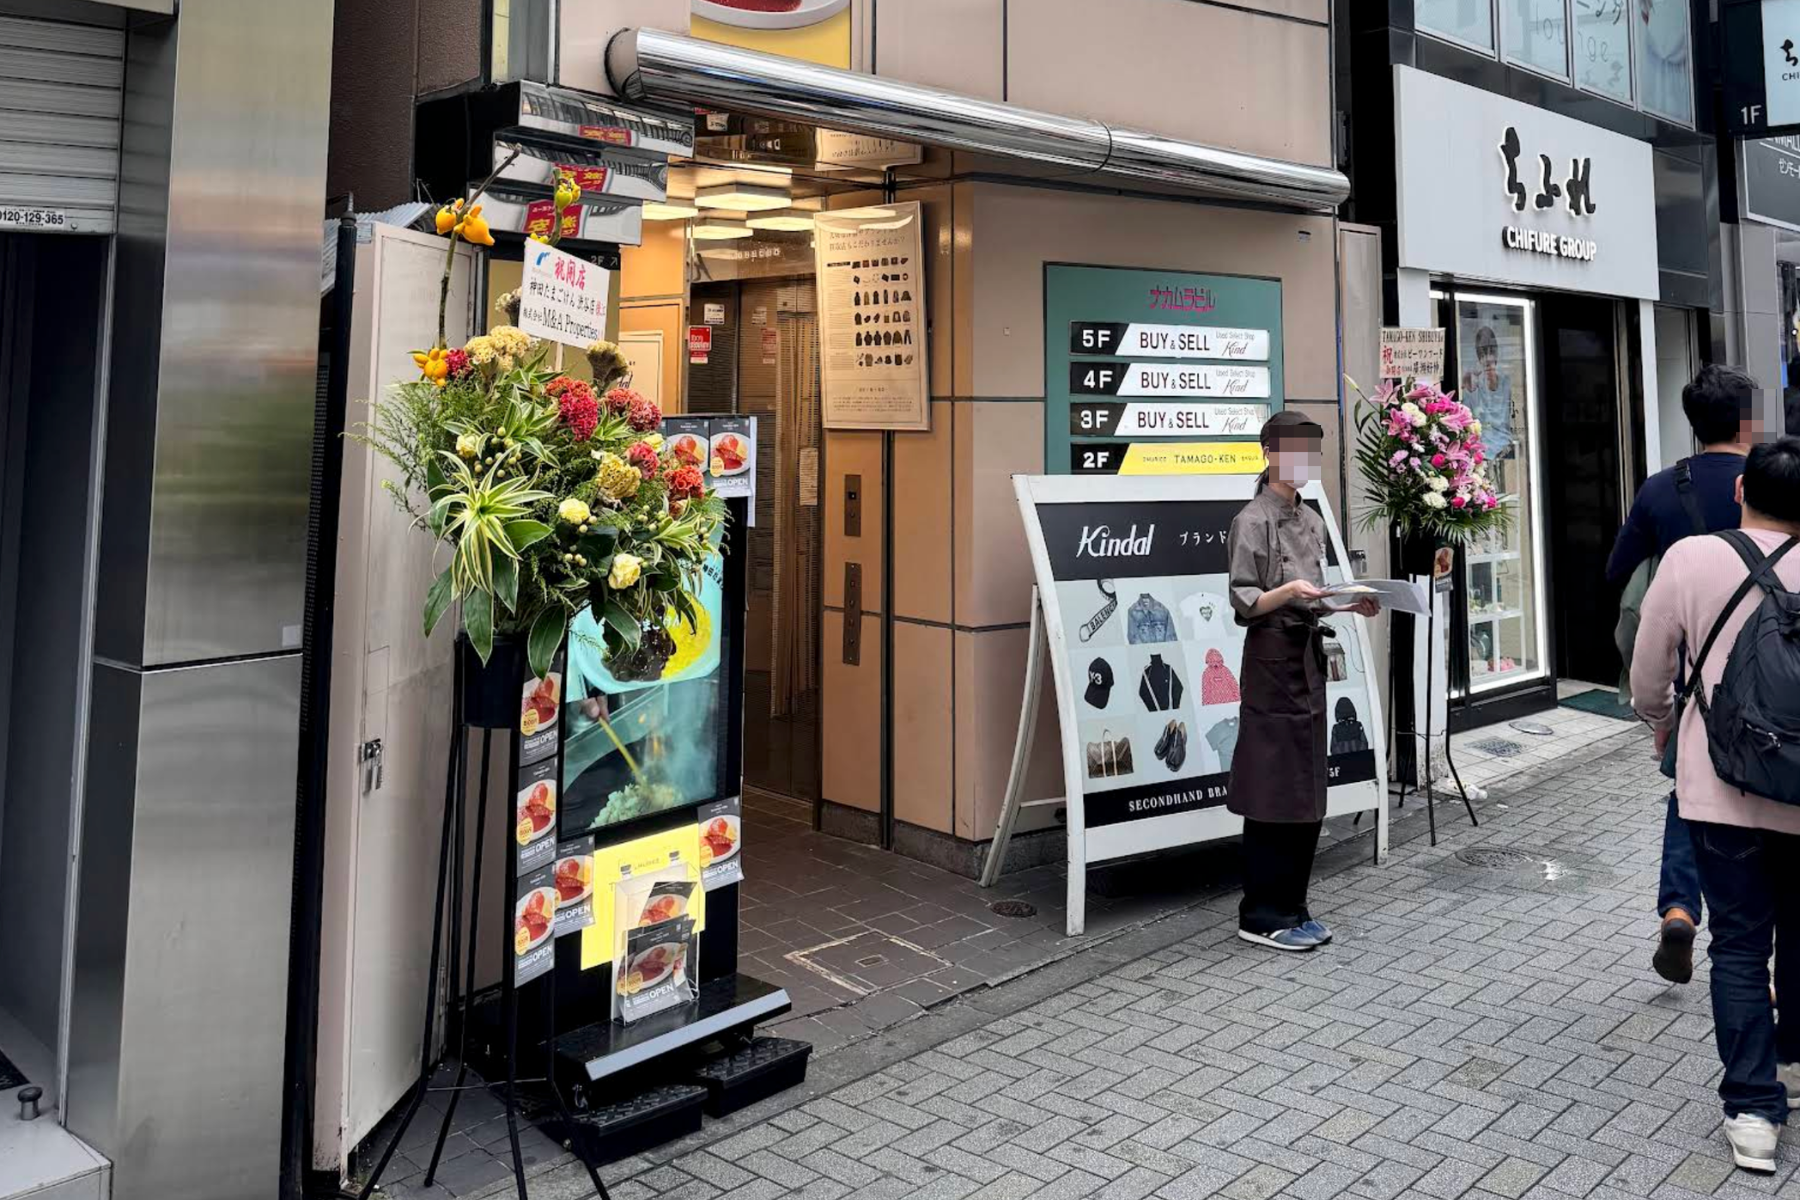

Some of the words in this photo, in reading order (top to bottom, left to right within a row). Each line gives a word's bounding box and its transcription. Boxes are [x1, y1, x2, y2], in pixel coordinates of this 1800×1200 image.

[1741, 105, 1762, 125] 1F
[1499, 127, 1596, 216] ちふれ
[1505, 225, 1558, 254] CHIFURE
[1559, 236, 1597, 260] GROUP
[1149, 284, 1216, 312] ナカムラビル
[1082, 329, 1111, 349] 5F
[1140, 332, 1169, 350] BUY
[1178, 333, 1210, 351] SELL
[1382, 345, 1393, 364] 祝
[1083, 370, 1113, 389] 4F
[1141, 371, 1169, 389] BUY
[1179, 372, 1211, 390] SELL
[1080, 410, 1109, 429] 3F
[1138, 411, 1167, 429] BUY
[1176, 411, 1209, 429] SELL
[1083, 452, 1109, 469] 2F
[1174, 454, 1236, 464] TAMAGO-KEN
[727, 477, 748, 486] OPEN
[1076, 524, 1155, 558] Kindal
[540, 730, 558, 743] OPEN
[1327, 766, 1341, 778] 5F
[1128, 788, 1203, 812] SECONDHAND
[535, 835, 555, 852] OPEN
[717, 860, 738, 874] OPEN
[565, 905, 591, 919] OPEN
[533, 945, 553, 962] OPEN
[649, 983, 674, 999] OPEN
